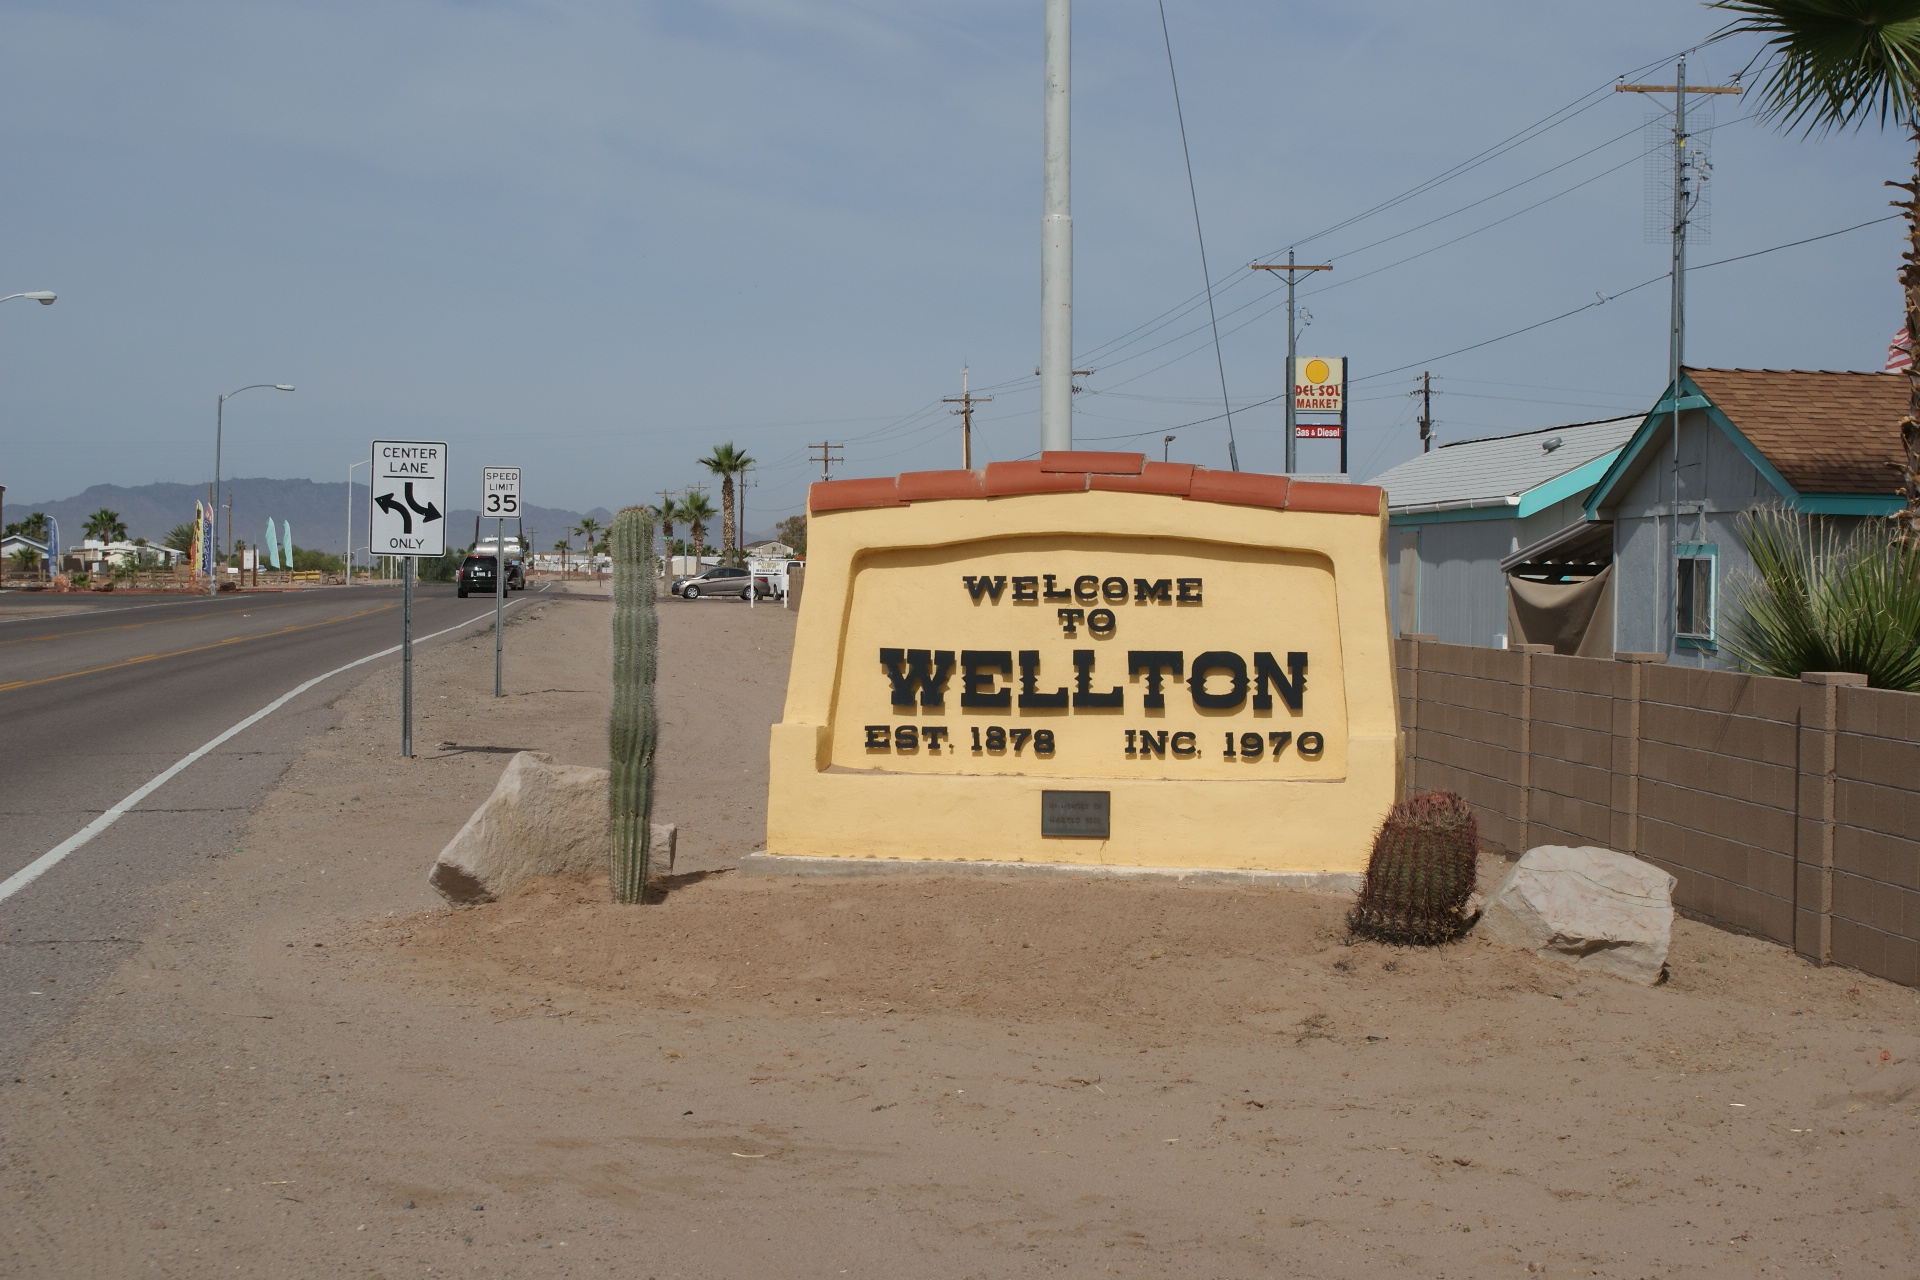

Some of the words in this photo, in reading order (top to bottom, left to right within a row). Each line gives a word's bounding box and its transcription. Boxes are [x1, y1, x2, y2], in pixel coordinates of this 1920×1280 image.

[1295, 384, 1315, 397] DEL
[1318, 384, 1340, 397] SOL
[1296, 398, 1338, 409] MARKET
[1295, 427, 1310, 437] Gas
[1317, 427, 1340, 437] Diesel
[383, 447, 437, 460] CENTER
[389, 462, 428, 474] LANE
[486, 472, 518, 480] SPEED
[489, 483, 515, 491] LIMIT
[486, 493, 518, 513] 35
[389, 537, 425, 549] ONLY
[962, 573, 1203, 604] WELCOME
[1057, 608, 1117, 634] TO
[879, 647, 1309, 711] WELLTON
[864, 724, 955, 751] EST.
[970, 725, 1056, 755] 1878
[1124, 728, 1203, 757] INC.
[1222, 730, 1325, 758] 1970
